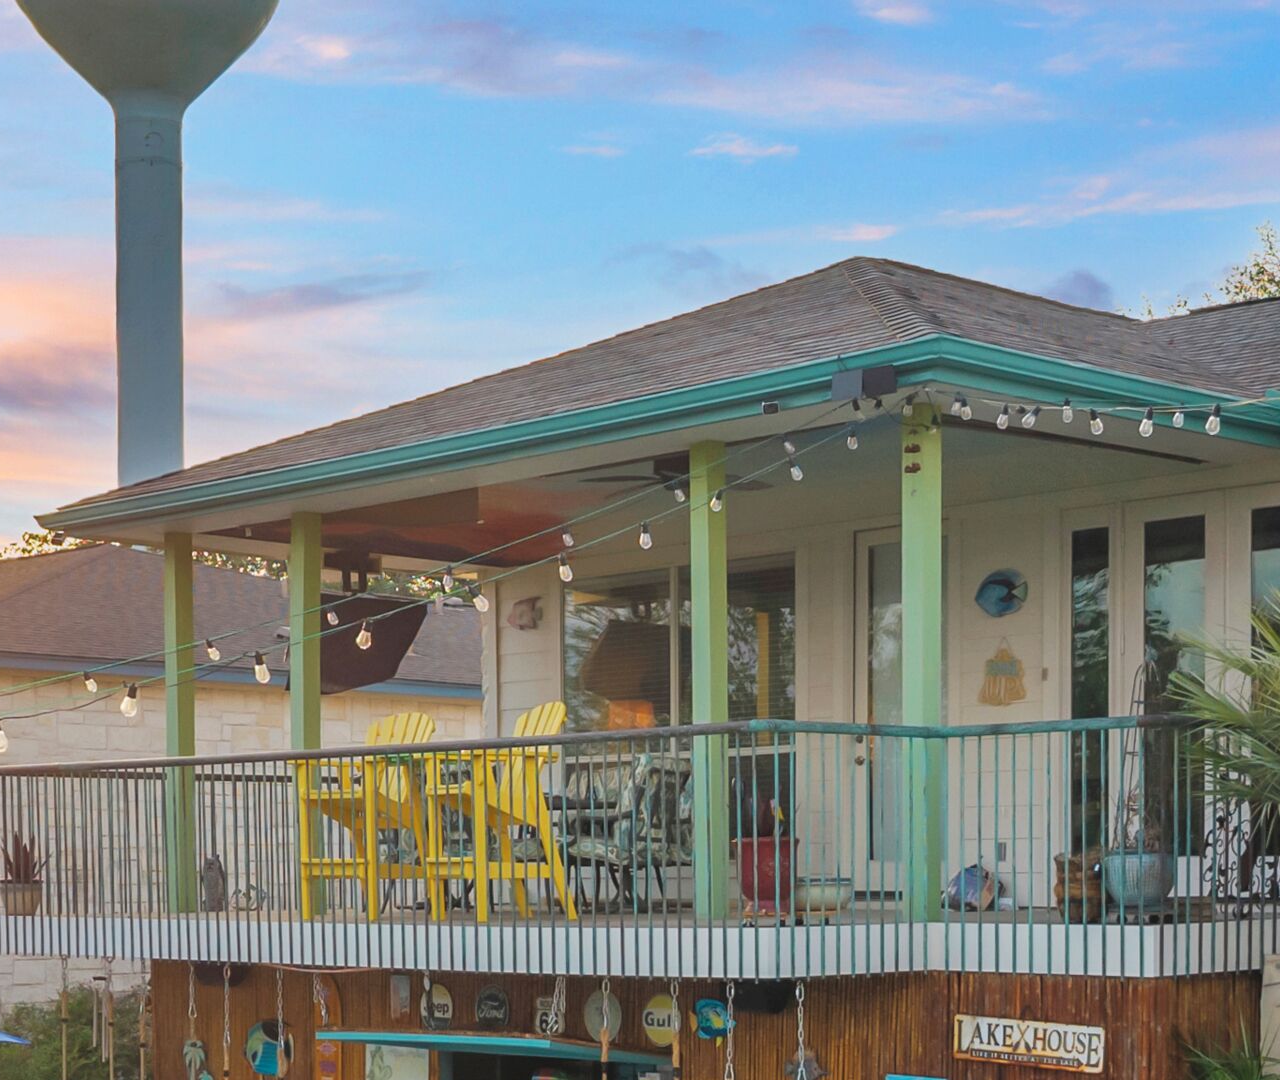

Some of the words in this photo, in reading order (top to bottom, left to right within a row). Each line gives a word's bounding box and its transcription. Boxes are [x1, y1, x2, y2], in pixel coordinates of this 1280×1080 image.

[424, 1003, 450, 1016] eep
[479, 1000, 505, 1018] Ford
[644, 1010, 675, 1028] Gul
[956, 1019, 1015, 1055] LAKE
[1033, 1027, 1101, 1068] HOUSE
